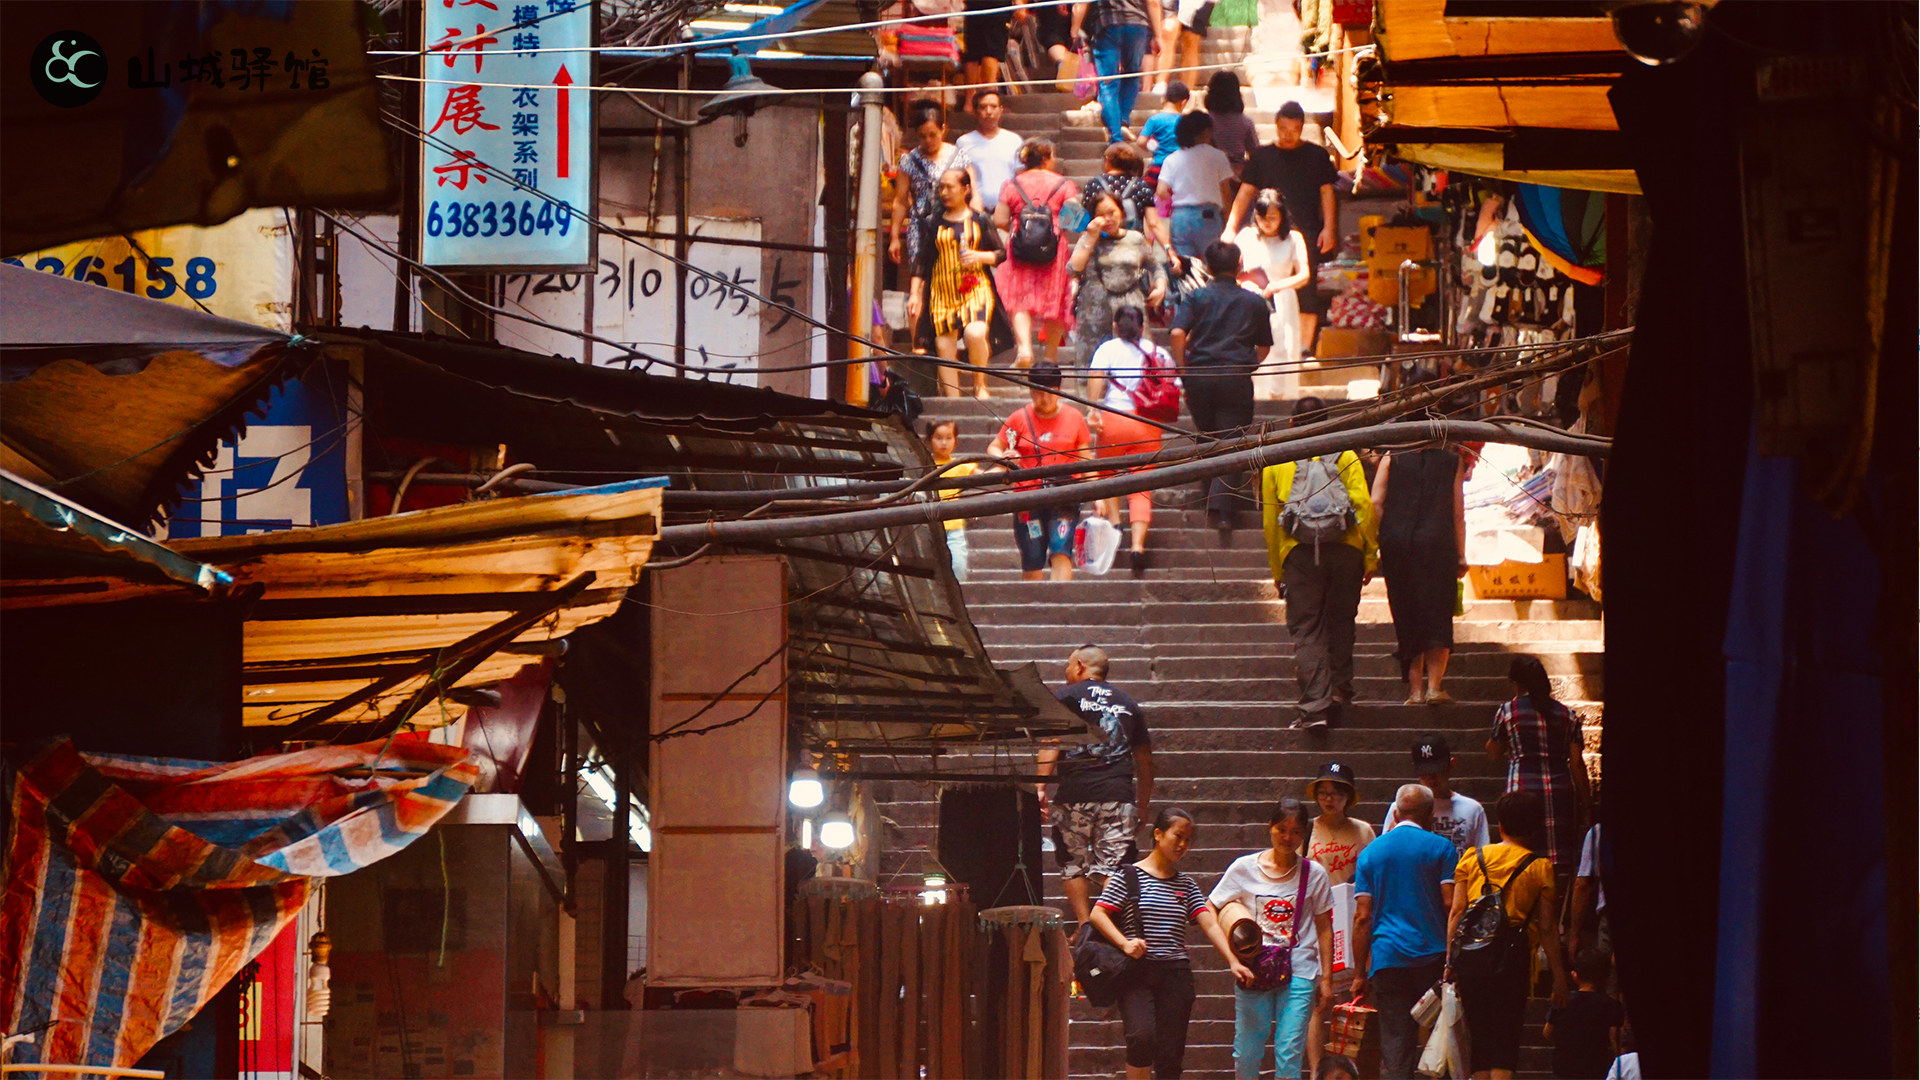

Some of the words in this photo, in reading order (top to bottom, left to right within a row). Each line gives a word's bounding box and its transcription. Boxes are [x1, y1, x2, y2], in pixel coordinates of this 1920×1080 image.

[512, 5, 540, 58] 模特
[512, 84, 540, 191] 衣架系列
[427, 200, 571, 238] 63833649
[0, 257, 217, 299] 6158
[600, 258, 662, 311] 310
[1087, 685, 1113, 698] THIS
